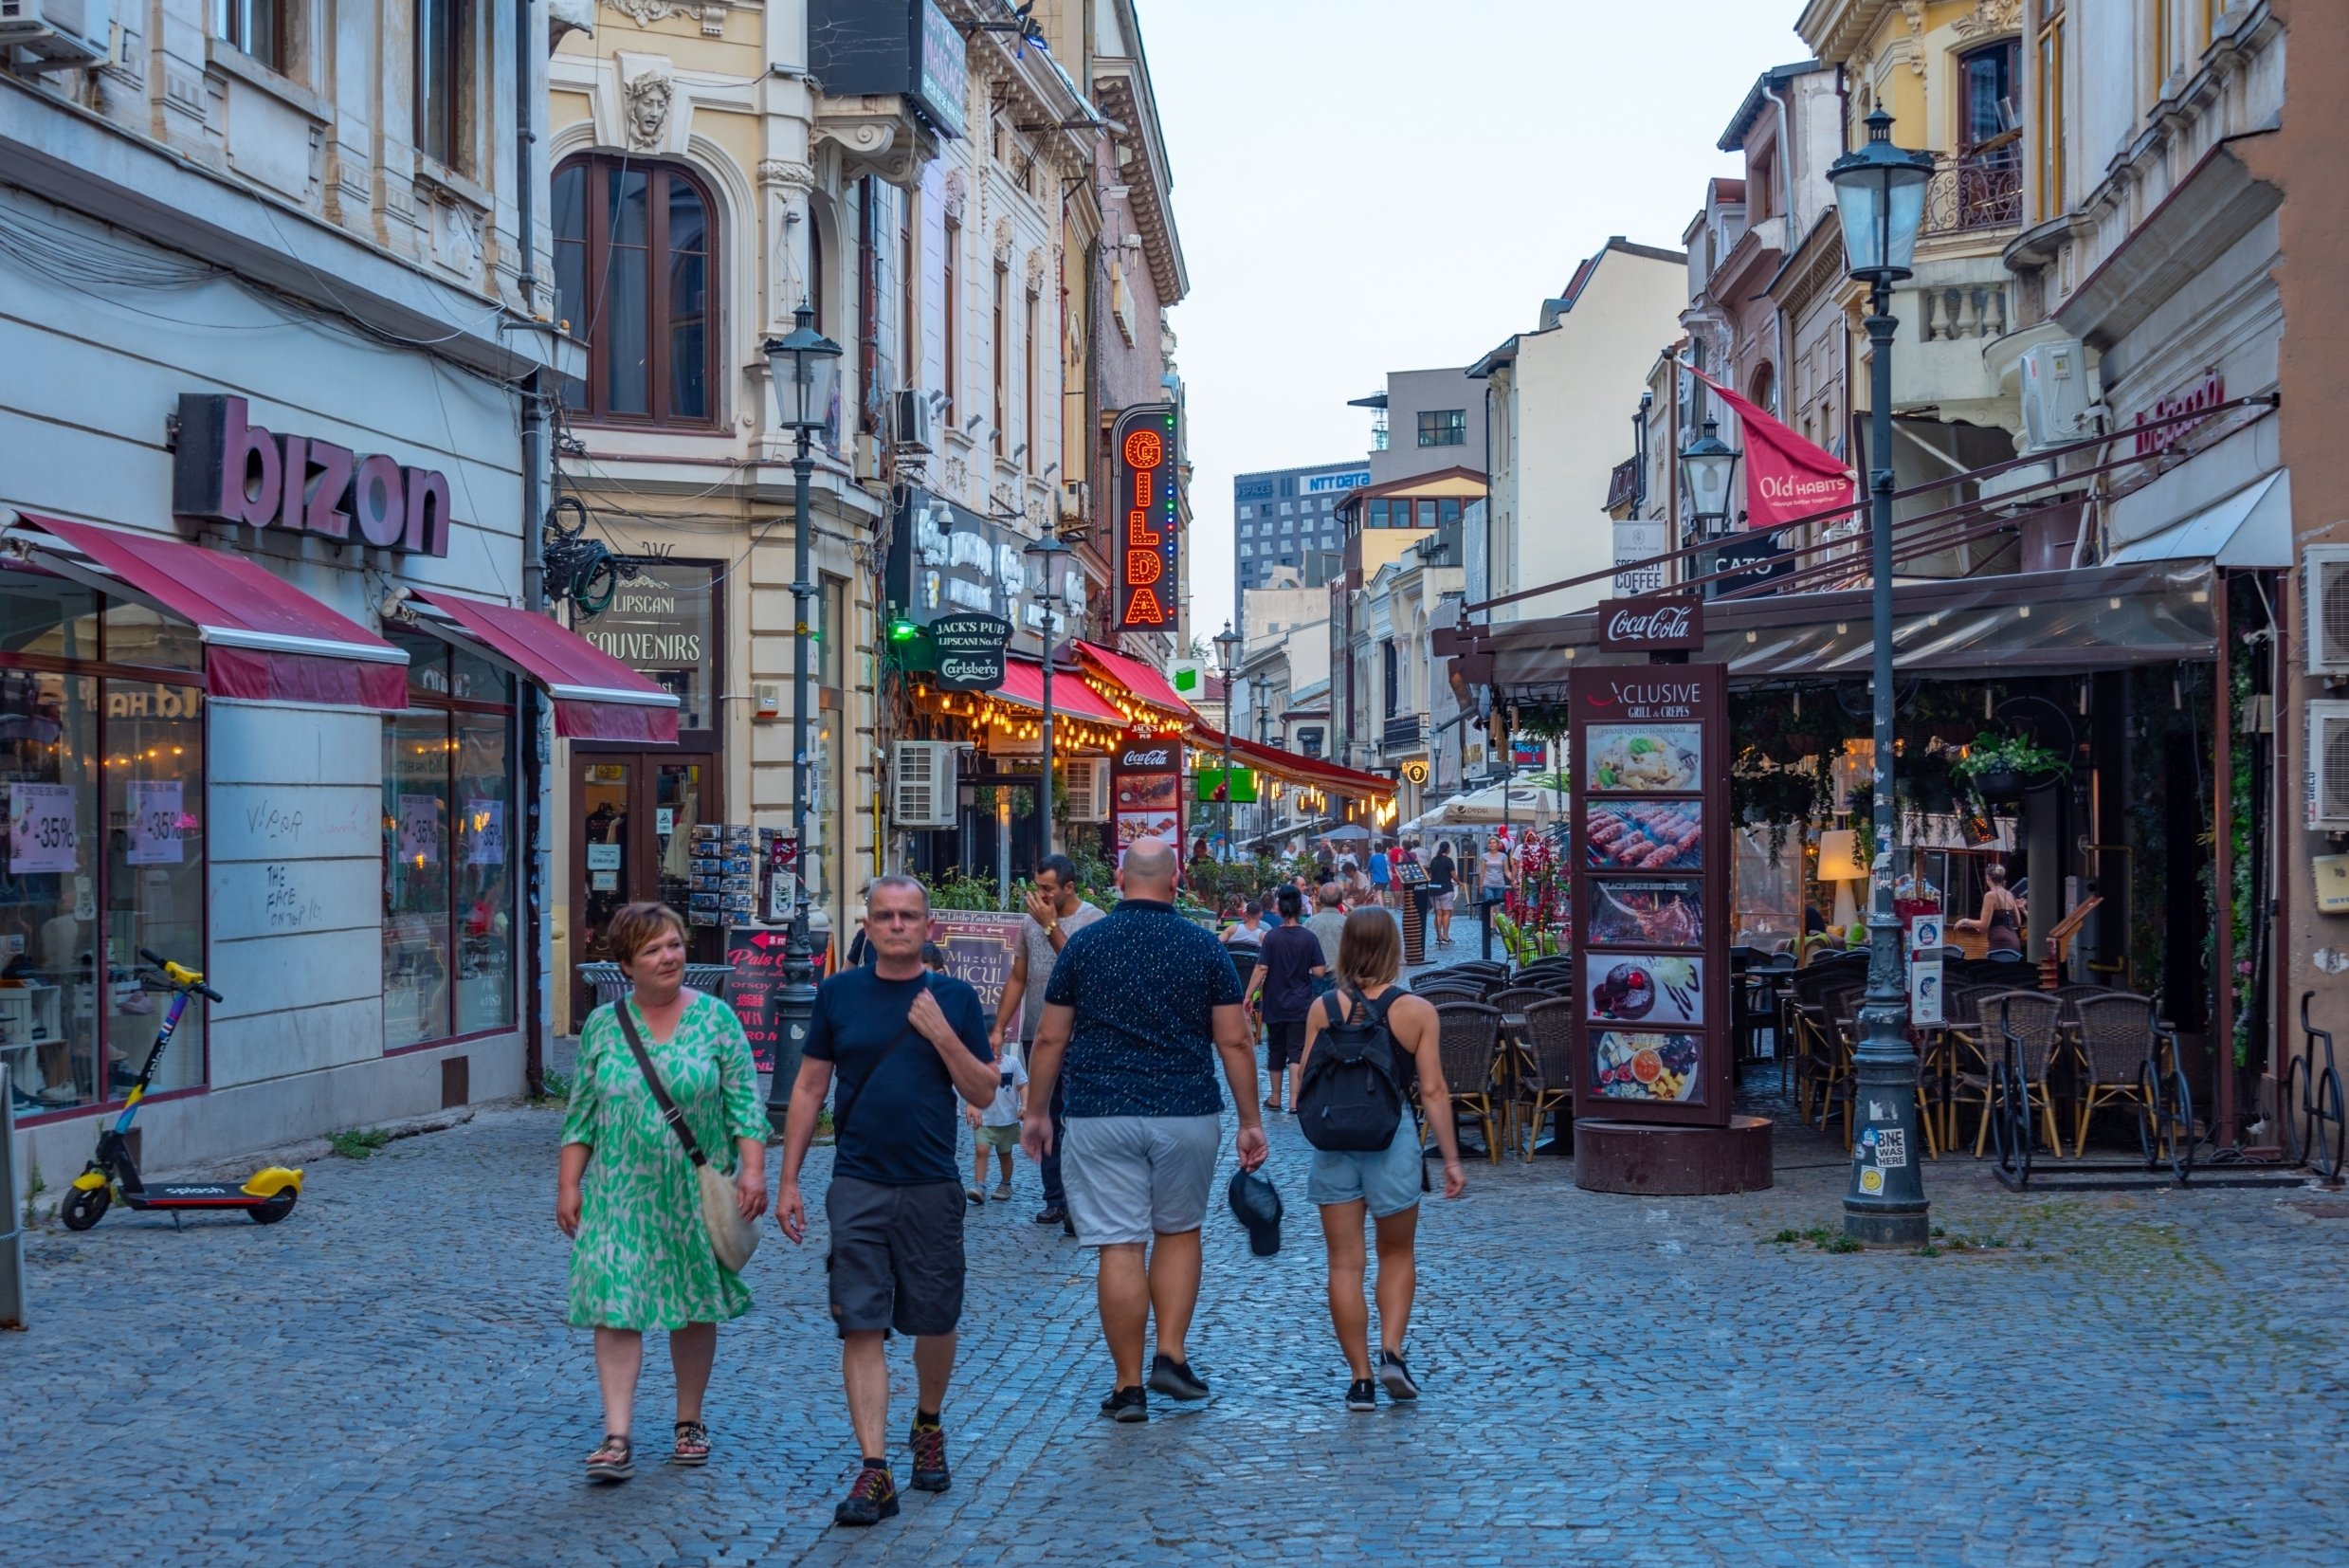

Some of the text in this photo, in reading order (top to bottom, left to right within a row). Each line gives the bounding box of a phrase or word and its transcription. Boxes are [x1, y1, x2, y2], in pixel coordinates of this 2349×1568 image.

[925, 30, 963, 107] MASSAGE
[218, 393, 451, 558] bizon
[1309, 476, 1335, 491] NTT
[1760, 475, 1848, 499] Old HABITS
[1125, 431, 1163, 624] GILDA
[1615, 573, 1662, 589] COFFEE
[613, 594, 674, 613] LIPSCANI
[936, 621, 1006, 635] JACK'S PUB
[586, 631, 701, 661] SOUVENIRS
[938, 637, 977, 646] LIPSCANI
[941, 658, 998, 682] Carlsberg
[1629, 706, 1651, 718] GRILL
[1661, 705, 1690, 718] CREPES
[1132, 723, 1158, 733] JACK'S
[34, 817, 75, 848] -35%
[147, 811, 183, 841] -35%
[266, 866, 285, 887] THE
[266, 887, 296, 914] FACE
[932, 911, 1023, 924] The Little Paris Museum
[728, 949, 773, 966] Pals
[946, 950, 1002, 965] Muzeul
[731, 982, 773, 993] orsay
[1878, 1130, 1903, 1148] BNE
[1879, 1147, 1903, 1158] WAS
[1879, 1157, 1904, 1166] HERE
[165, 1186, 226, 1196] splash
